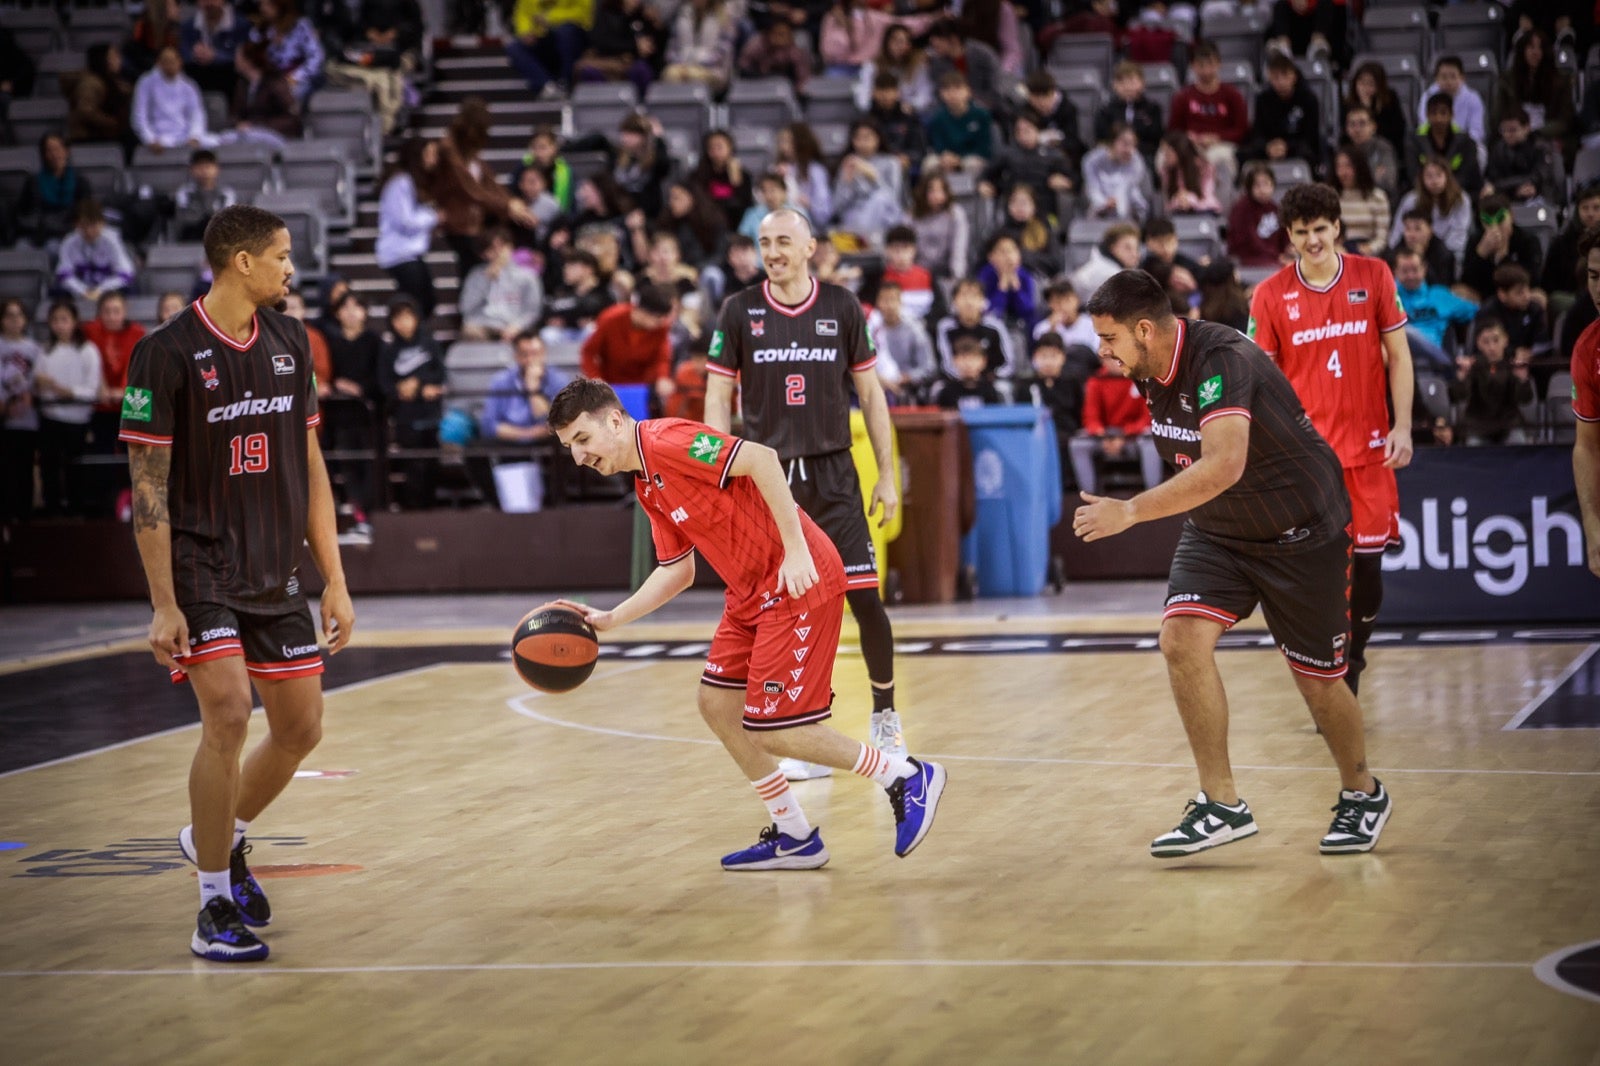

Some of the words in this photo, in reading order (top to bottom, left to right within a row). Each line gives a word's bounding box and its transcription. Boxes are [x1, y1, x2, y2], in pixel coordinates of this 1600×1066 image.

[1327, 349, 1342, 378] 4
[785, 374, 806, 405] 2
[229, 432, 269, 475] 19
[1289, 650, 1331, 668] BERNER
